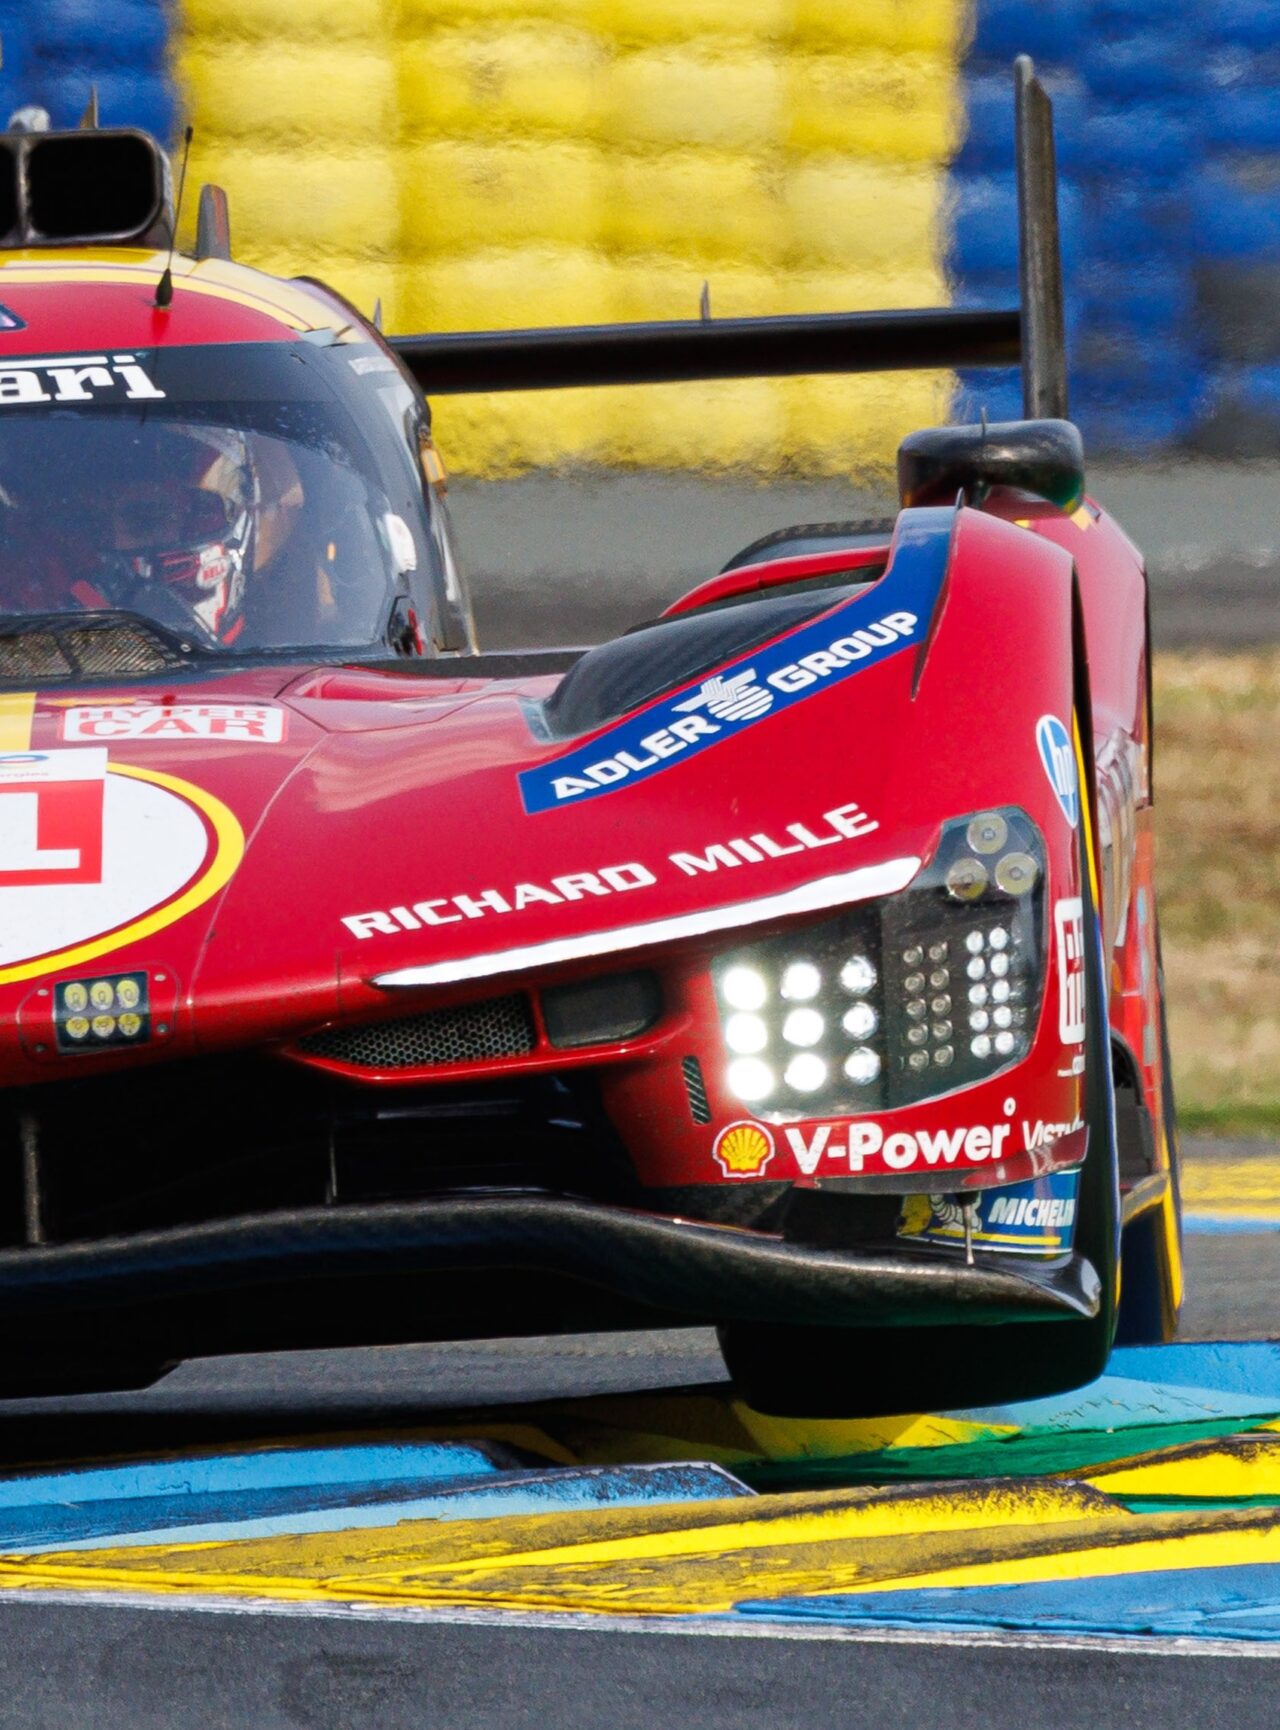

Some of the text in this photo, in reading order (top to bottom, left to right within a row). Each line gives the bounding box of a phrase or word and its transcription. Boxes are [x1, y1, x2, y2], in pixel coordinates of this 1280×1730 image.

[78, 707, 267, 719] HYPER
[78, 718, 266, 737] CAR
[549, 611, 918, 799] ADLER GROUP
[341, 803, 880, 941] RICHARD MILLE
[784, 1121, 1011, 1175] V-Power
